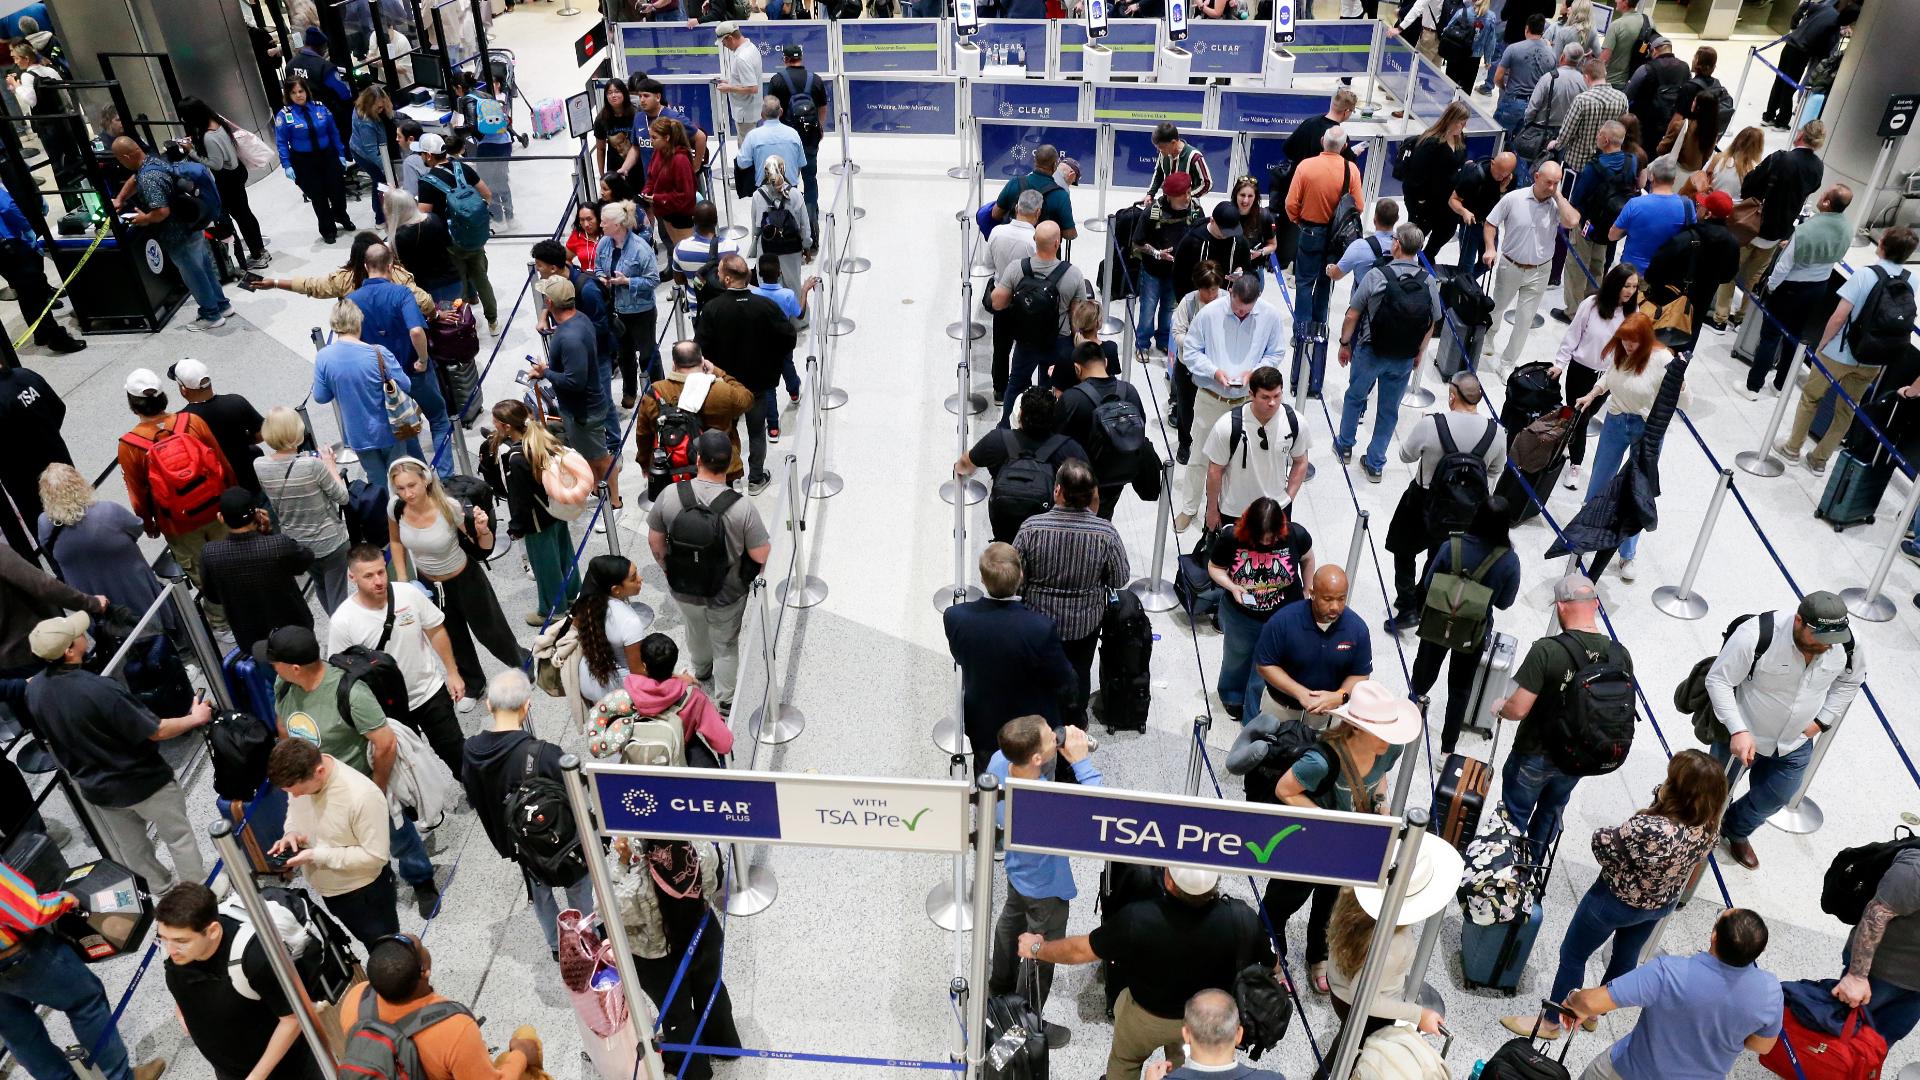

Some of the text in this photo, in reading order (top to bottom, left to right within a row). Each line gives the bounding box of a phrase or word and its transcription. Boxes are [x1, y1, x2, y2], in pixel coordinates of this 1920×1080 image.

[293, 68, 308, 79] TSA
[1018, 106, 1050, 115] CLEAR
[17, 386, 40, 407] TSA
[670, 798, 749, 815] CLEAR
[852, 798, 887, 807] WITH
[725, 814, 750, 822] PLUS
[815, 809, 900, 828] TSA Pre
[1091, 815, 1242, 855] TSA Pre
